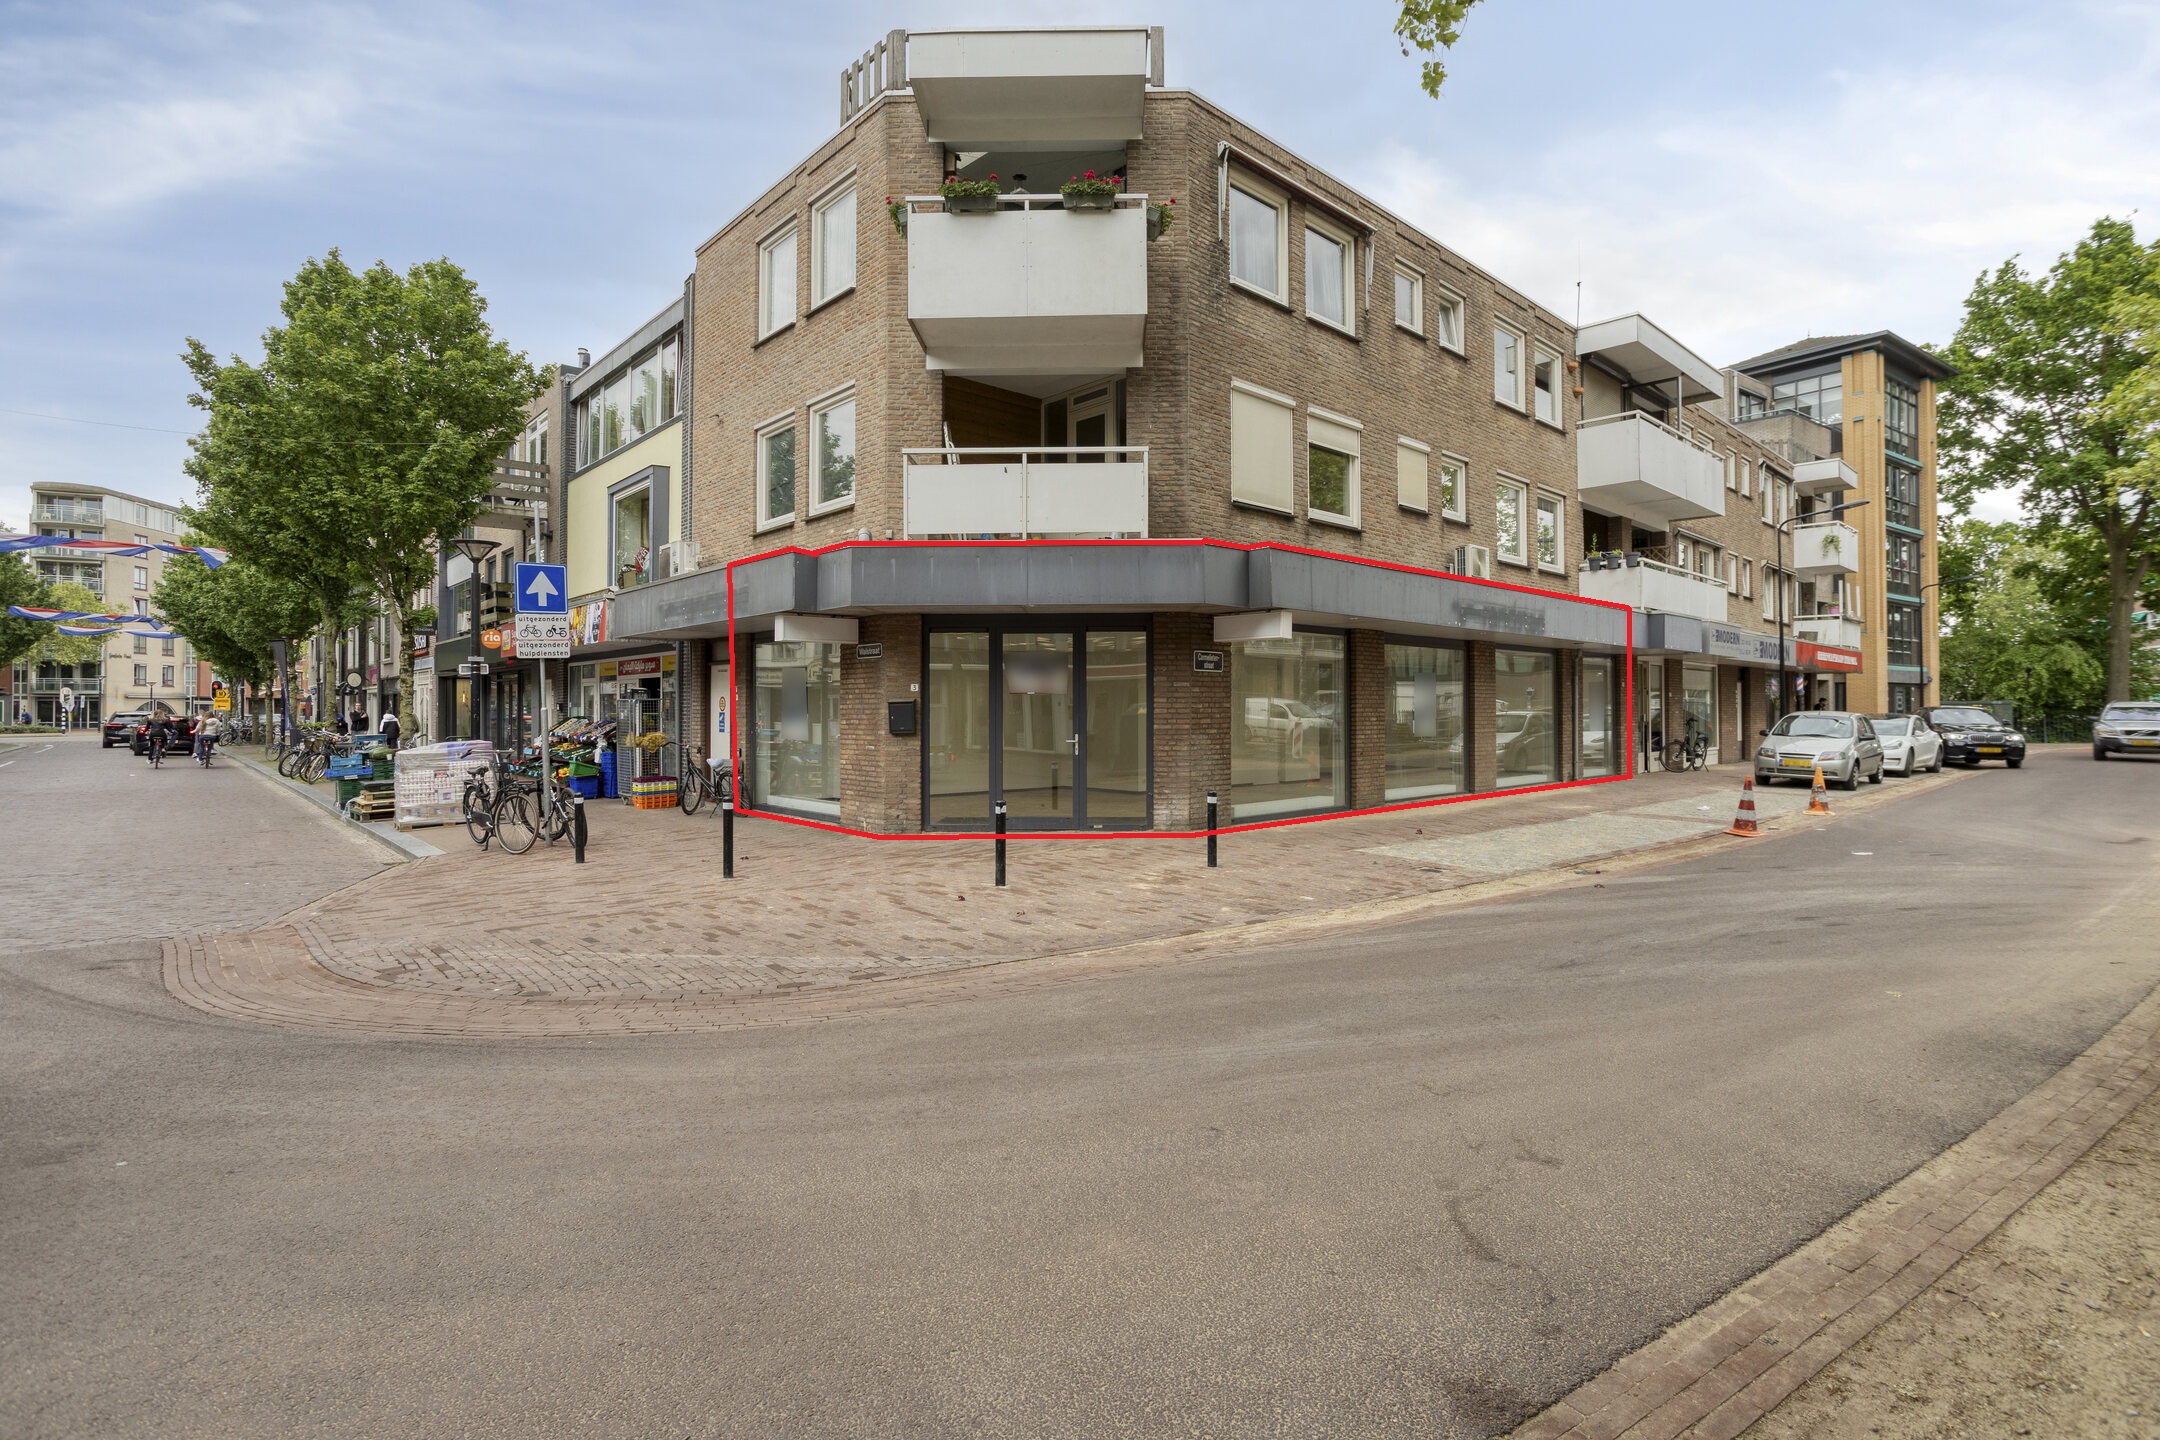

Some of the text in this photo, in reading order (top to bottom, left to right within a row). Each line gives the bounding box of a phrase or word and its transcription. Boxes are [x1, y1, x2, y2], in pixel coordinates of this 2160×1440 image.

[484, 631, 501, 642] ria
[1716, 630, 1740, 645] MODERN
[518, 642, 569, 650] uitgezonderd
[1761, 641, 1790, 661] MODN
